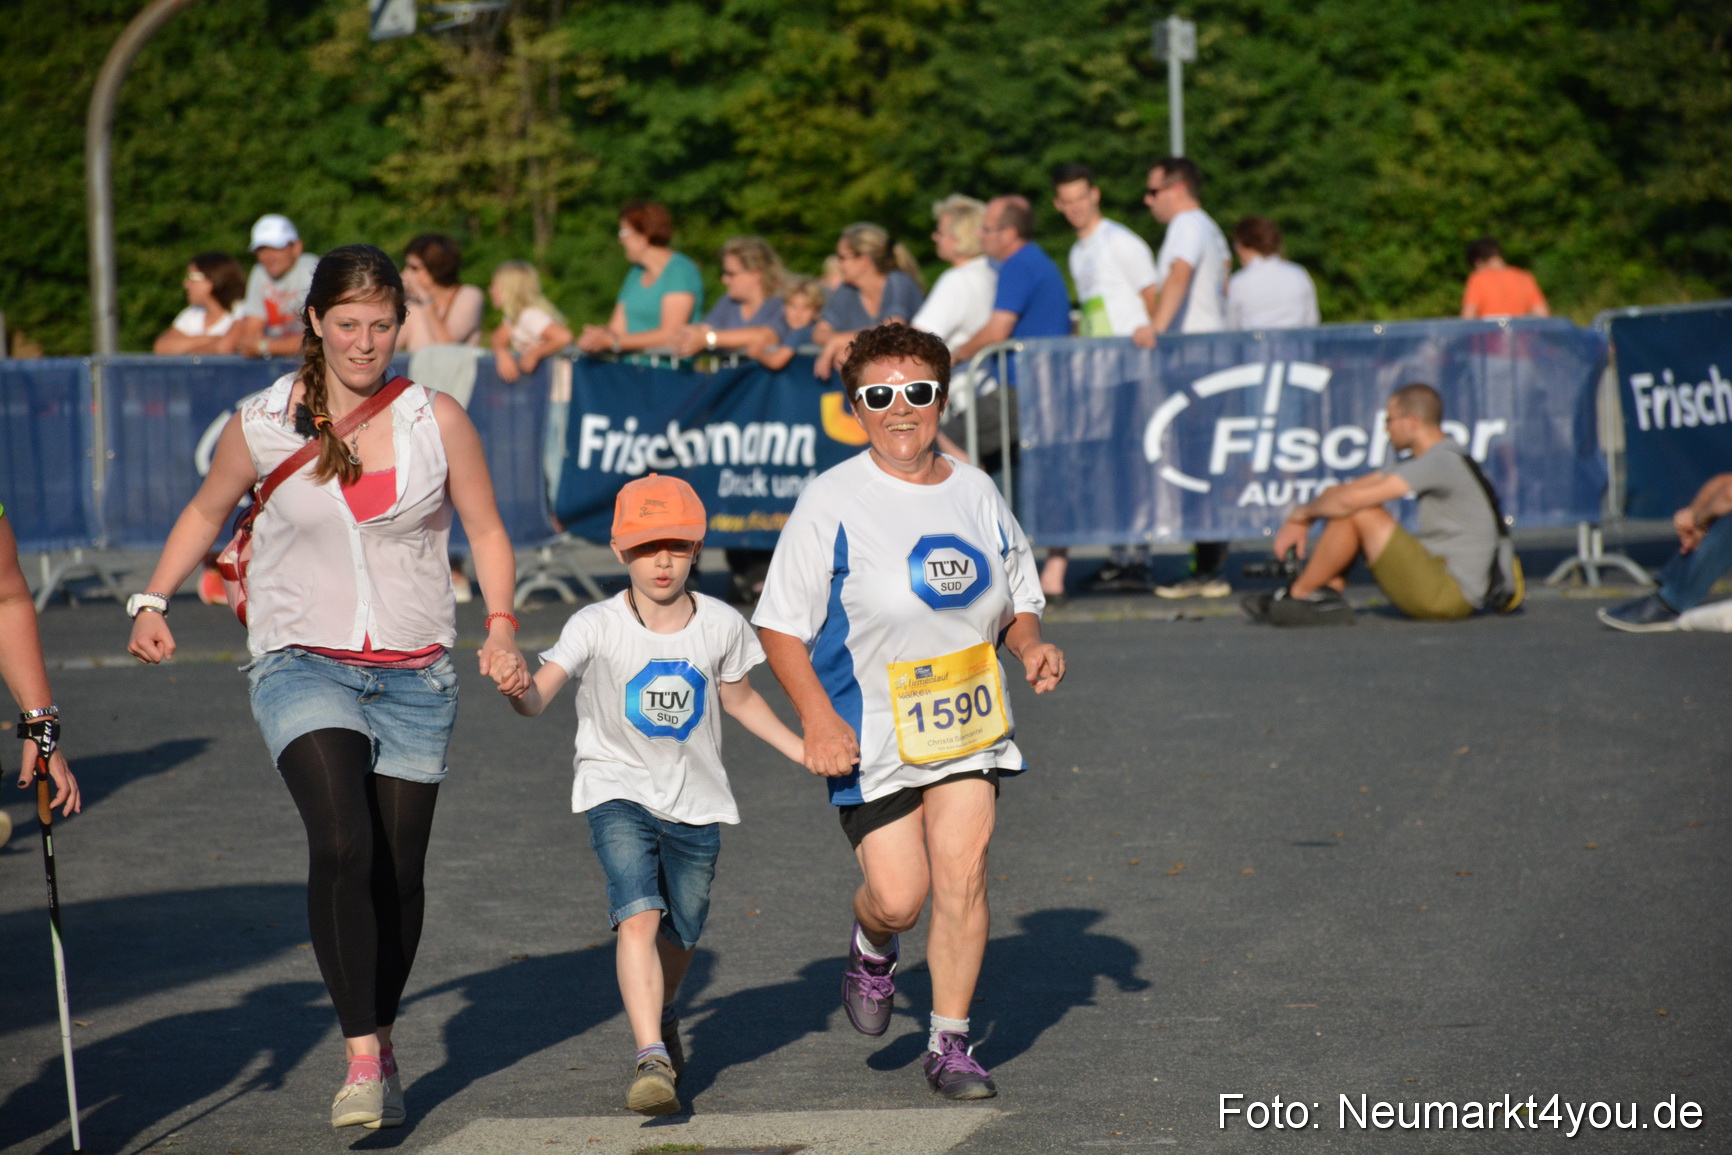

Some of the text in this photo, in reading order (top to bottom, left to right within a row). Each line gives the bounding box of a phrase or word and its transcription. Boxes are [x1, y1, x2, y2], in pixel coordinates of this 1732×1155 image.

[577, 413, 817, 476] Frischmann
[927, 559, 969, 577] TÜV
[940, 581, 962, 591] SÜD
[646, 690, 690, 709] TÜV
[907, 684, 992, 733] 1590
[657, 713, 679, 725] SÜD
